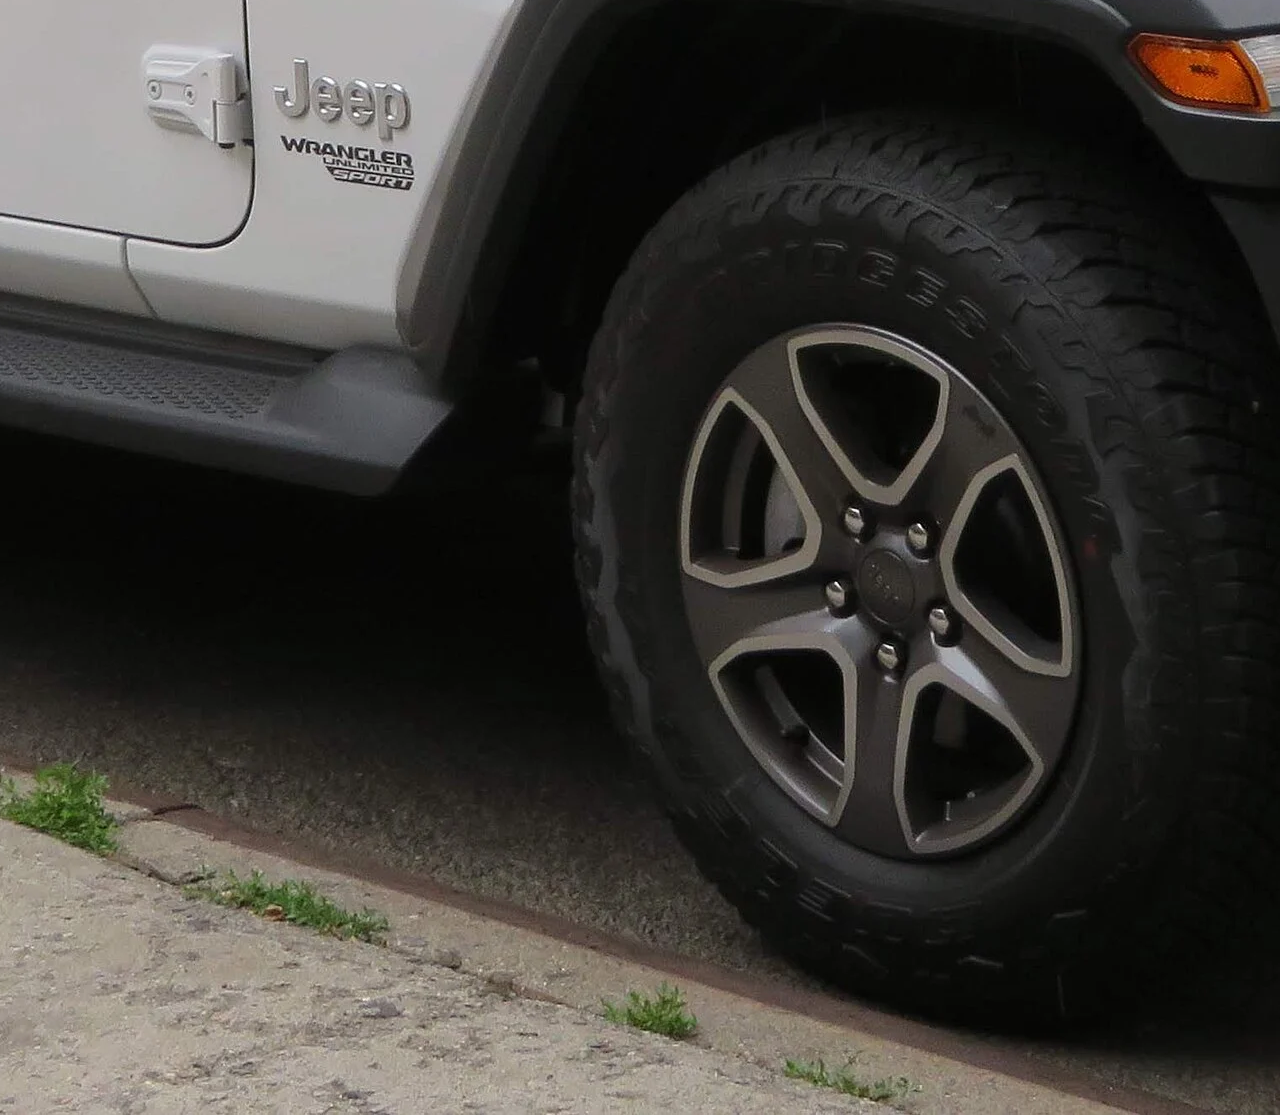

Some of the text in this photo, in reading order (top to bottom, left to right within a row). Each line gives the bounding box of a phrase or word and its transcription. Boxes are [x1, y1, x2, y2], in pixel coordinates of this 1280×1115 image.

[273, 58, 411, 141] Jeep
[280, 135, 414, 169] WRANGLER
[322, 156, 415, 176] UNLIMITED
[333, 169, 414, 189] SPORT
